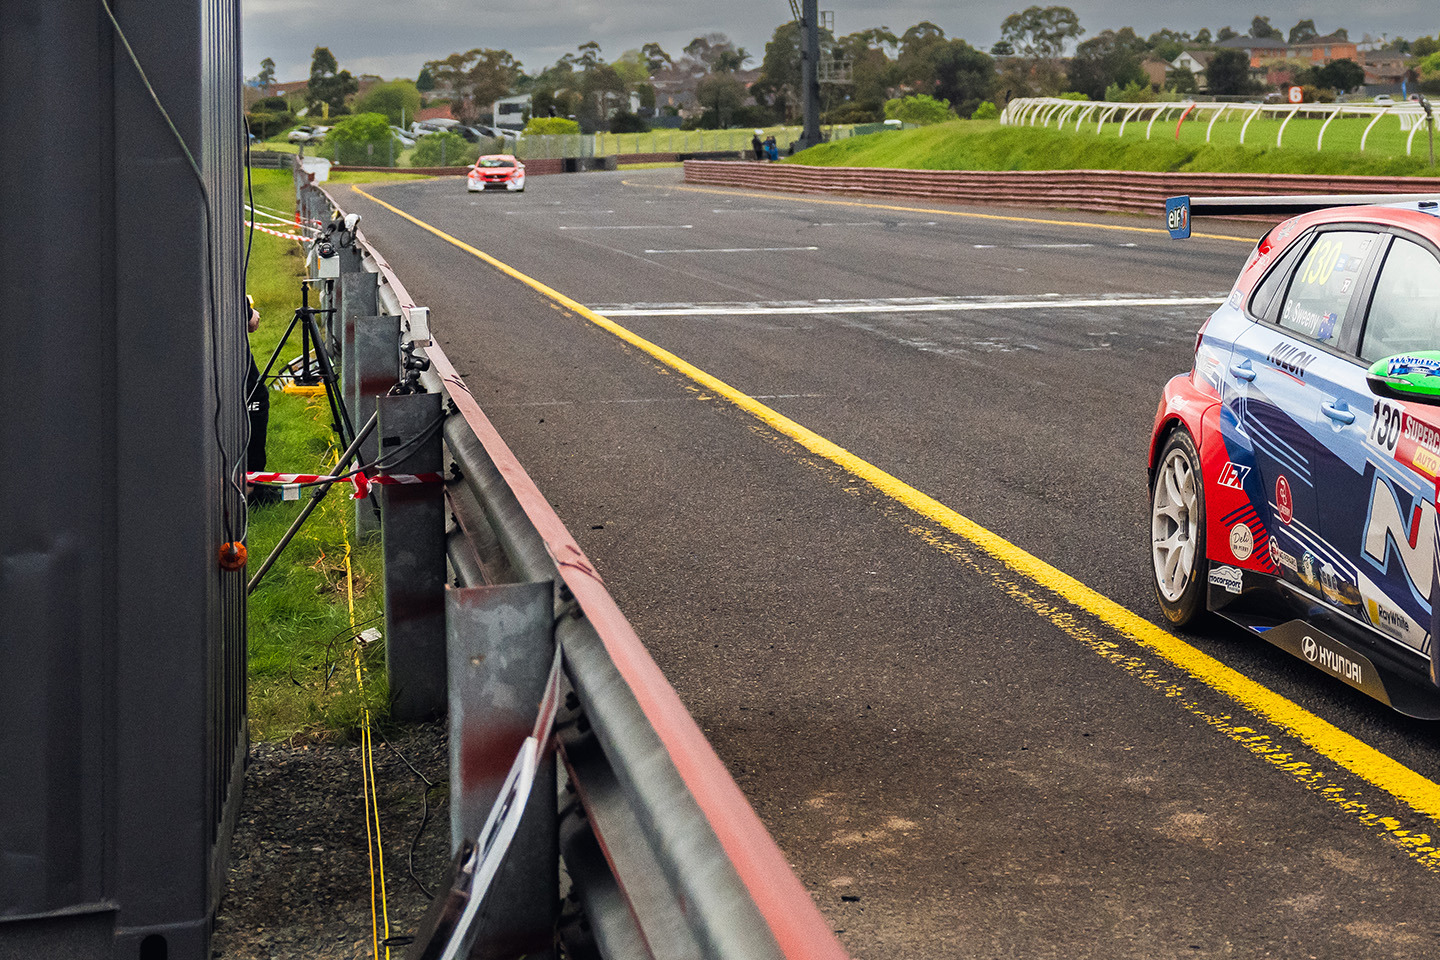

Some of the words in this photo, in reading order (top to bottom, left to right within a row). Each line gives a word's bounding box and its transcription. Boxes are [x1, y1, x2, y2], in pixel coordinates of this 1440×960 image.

[1290, 86, 1302, 102] 6
[1168, 208, 1180, 229] elf
[1302, 240, 1342, 286] 130
[1284, 300, 1292, 319] B.
[1292, 302, 1320, 334] Sweeny
[1266, 342, 1317, 378] NULON
[1370, 398, 1400, 451] 130
[1416, 451, 1437, 471] AUTO
[1234, 532, 1250, 544] Deli
[1364, 477, 1436, 601] N
[1209, 575, 1241, 588] motorsport
[1319, 646, 1362, 684] HYUNDAI
